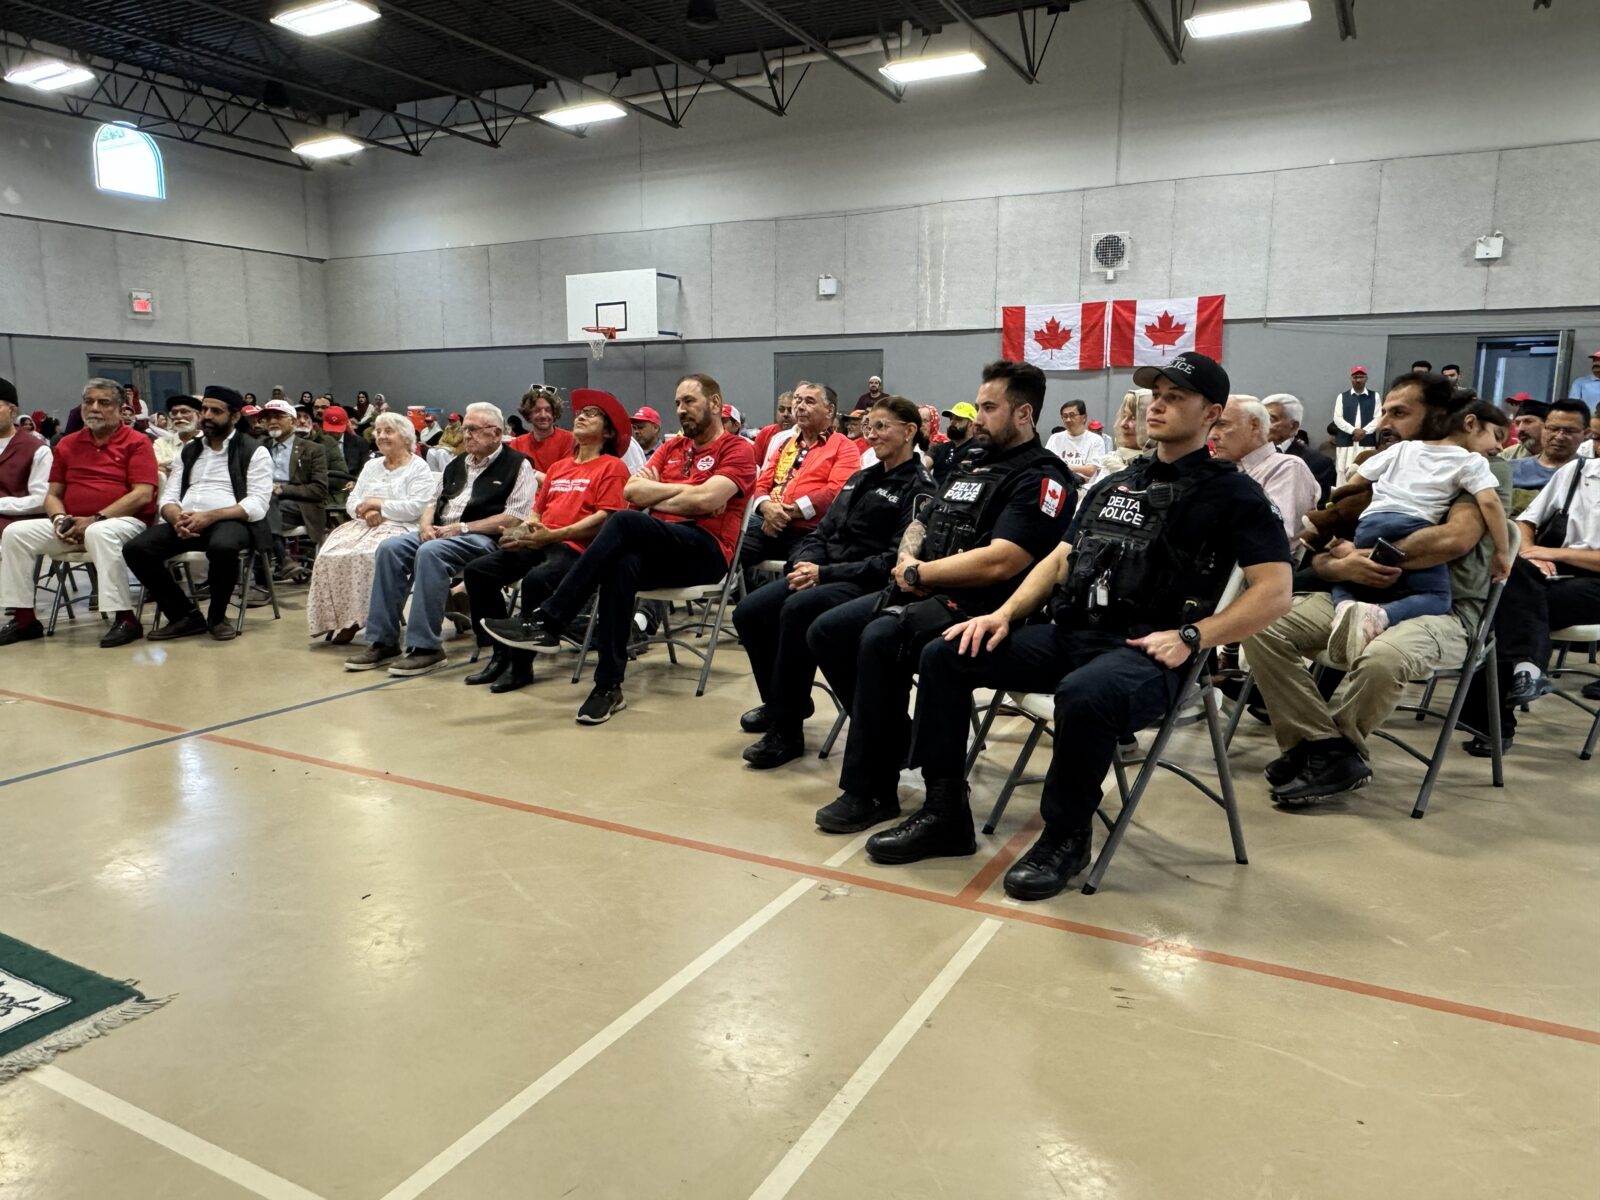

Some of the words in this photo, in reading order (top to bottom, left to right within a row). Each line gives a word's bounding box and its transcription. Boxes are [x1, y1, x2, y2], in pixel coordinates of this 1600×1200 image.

[1163, 360, 1196, 375] LICE
[951, 481, 983, 493] DELTA
[875, 487, 900, 503] POLICE
[943, 489, 979, 502] POLICE
[1107, 495, 1141, 513] DELTA
[1098, 506, 1145, 526] POLICE
